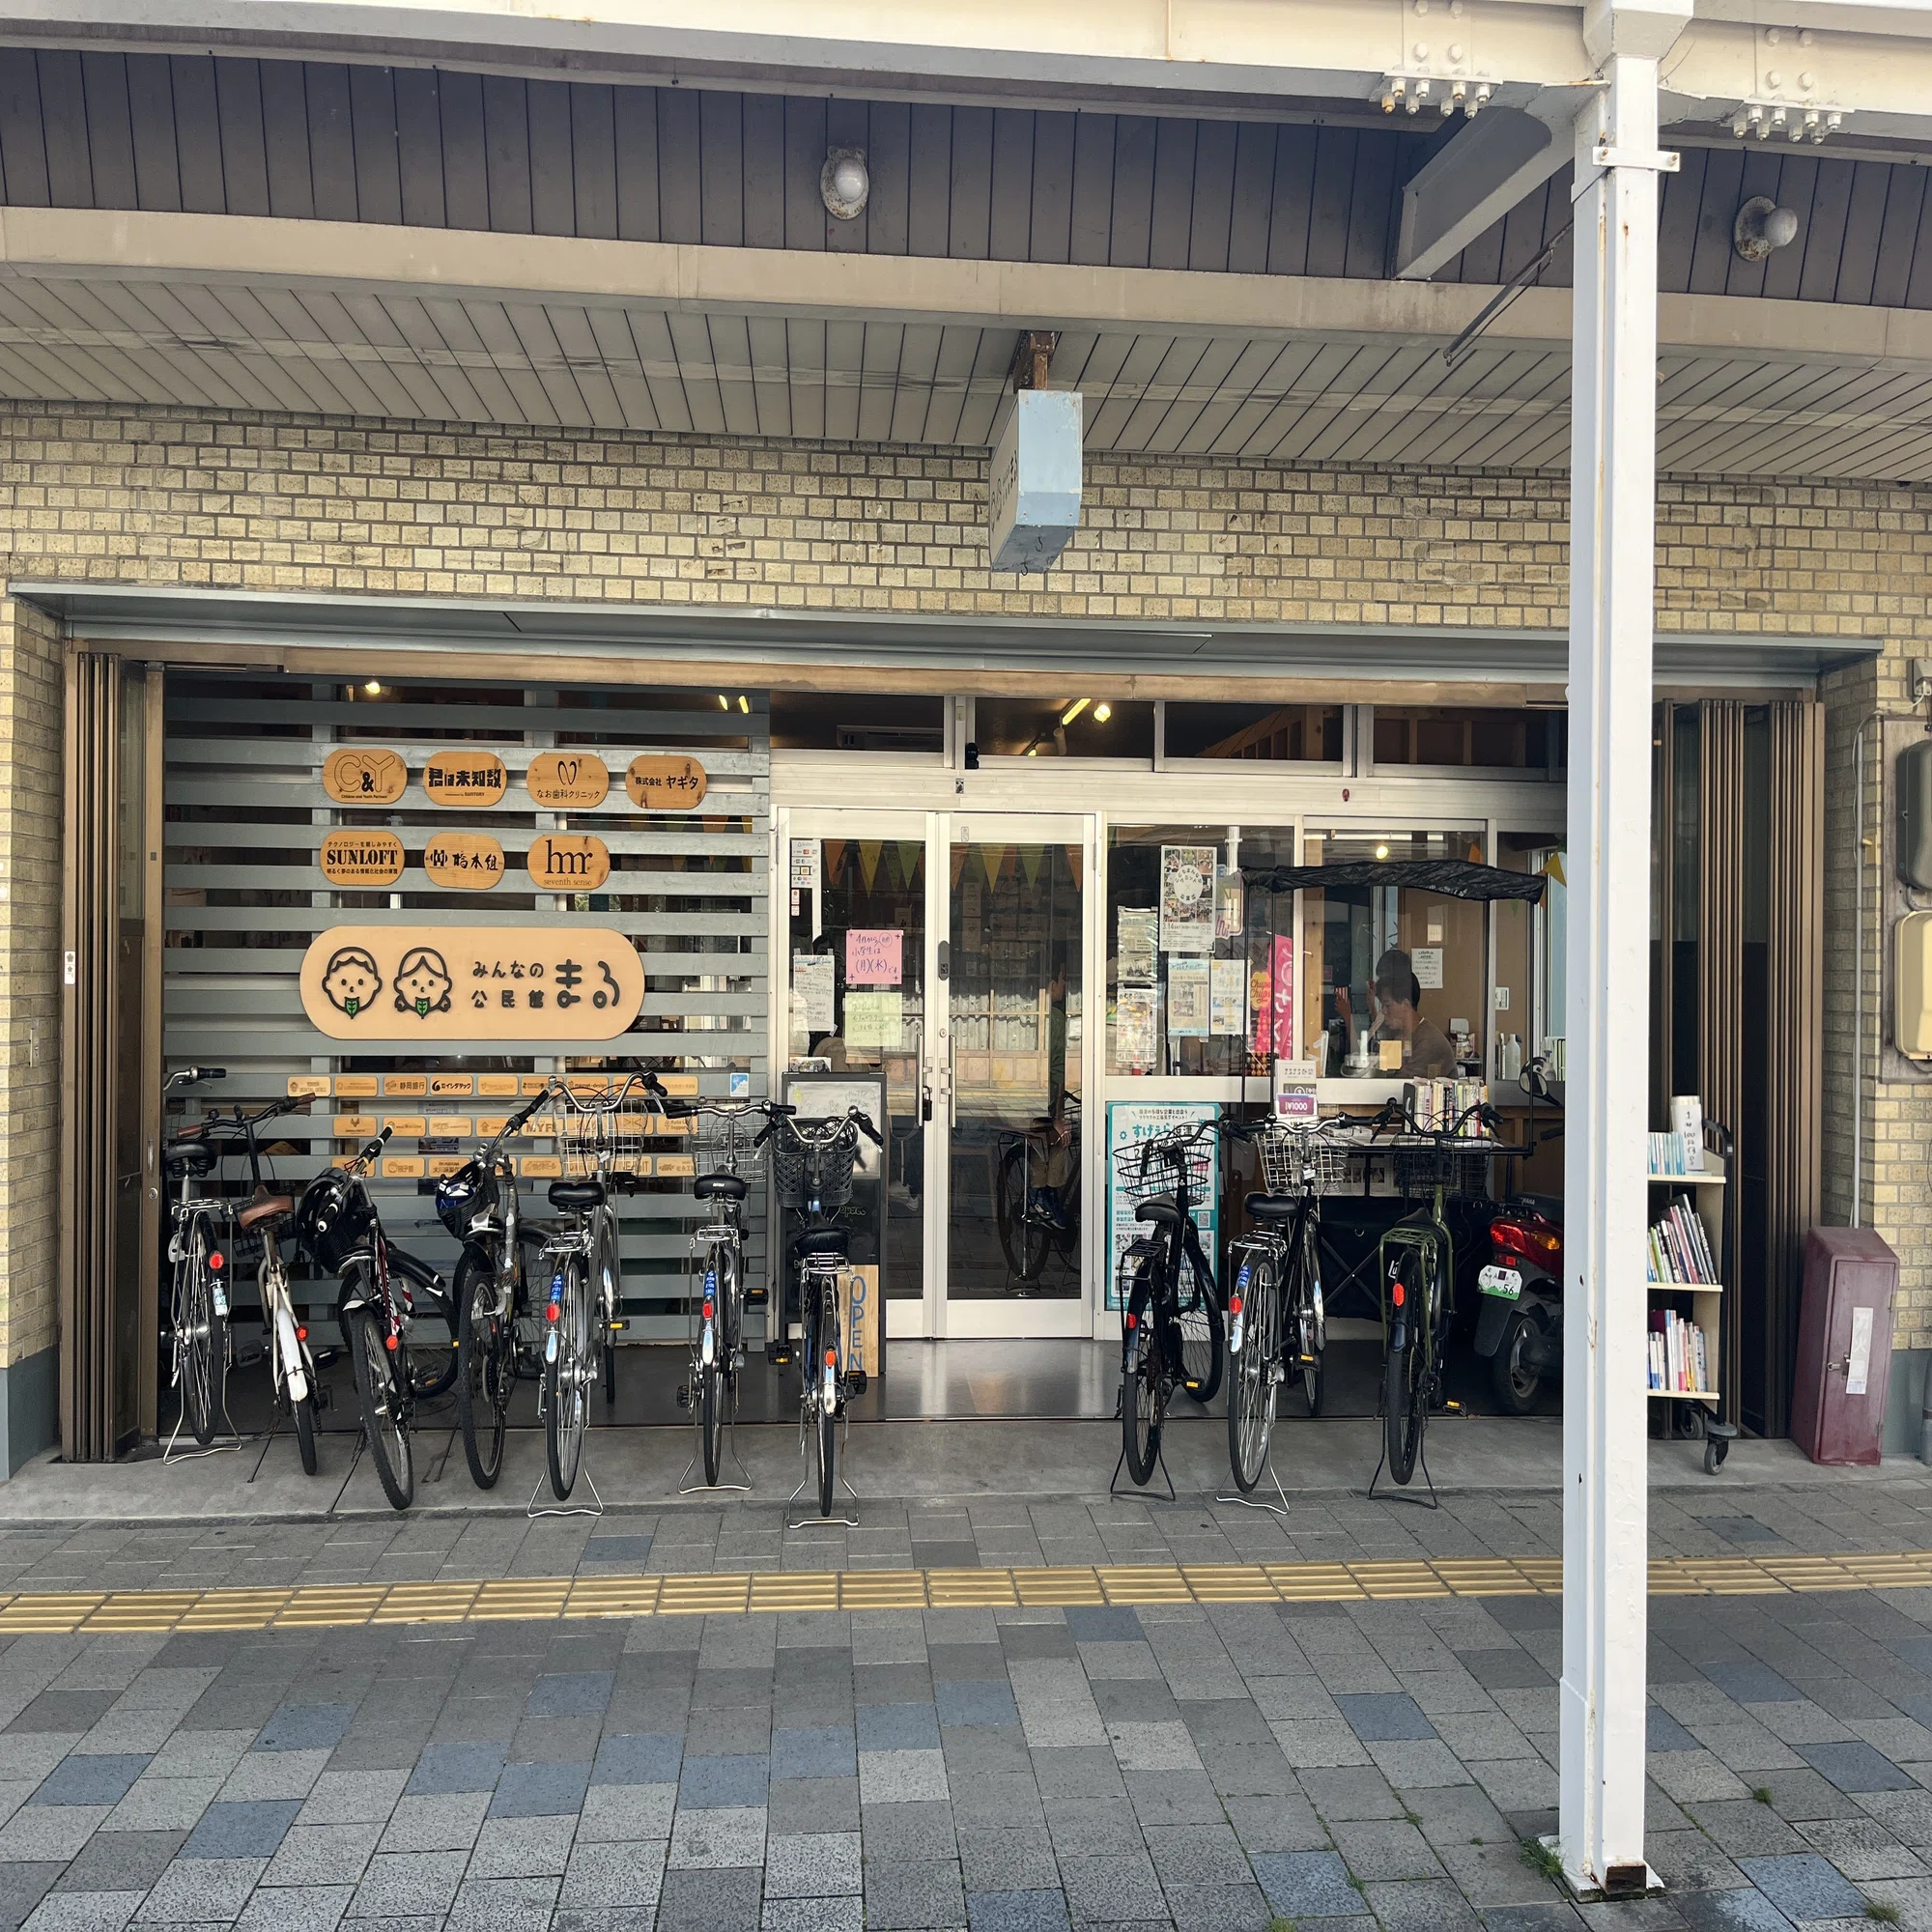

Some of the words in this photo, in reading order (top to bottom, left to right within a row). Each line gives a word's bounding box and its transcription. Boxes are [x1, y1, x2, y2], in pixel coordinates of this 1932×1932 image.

[428, 767, 501, 789] 君は未知数
[635, 776, 663, 786] 株式会社
[666, 775, 699, 790] ヤギタ
[537, 788, 600, 800] なお歯科クリニック
[327, 849, 398, 866] SUNLOFT
[543, 877, 572, 886] seventh
[472, 959, 545, 979] みんなの
[554, 958, 621, 1009] まる
[470, 989, 545, 1009] 公民館
[399, 1081, 425, 1091] 静岡銀行
[848, 1274, 867, 1371] OPEN
